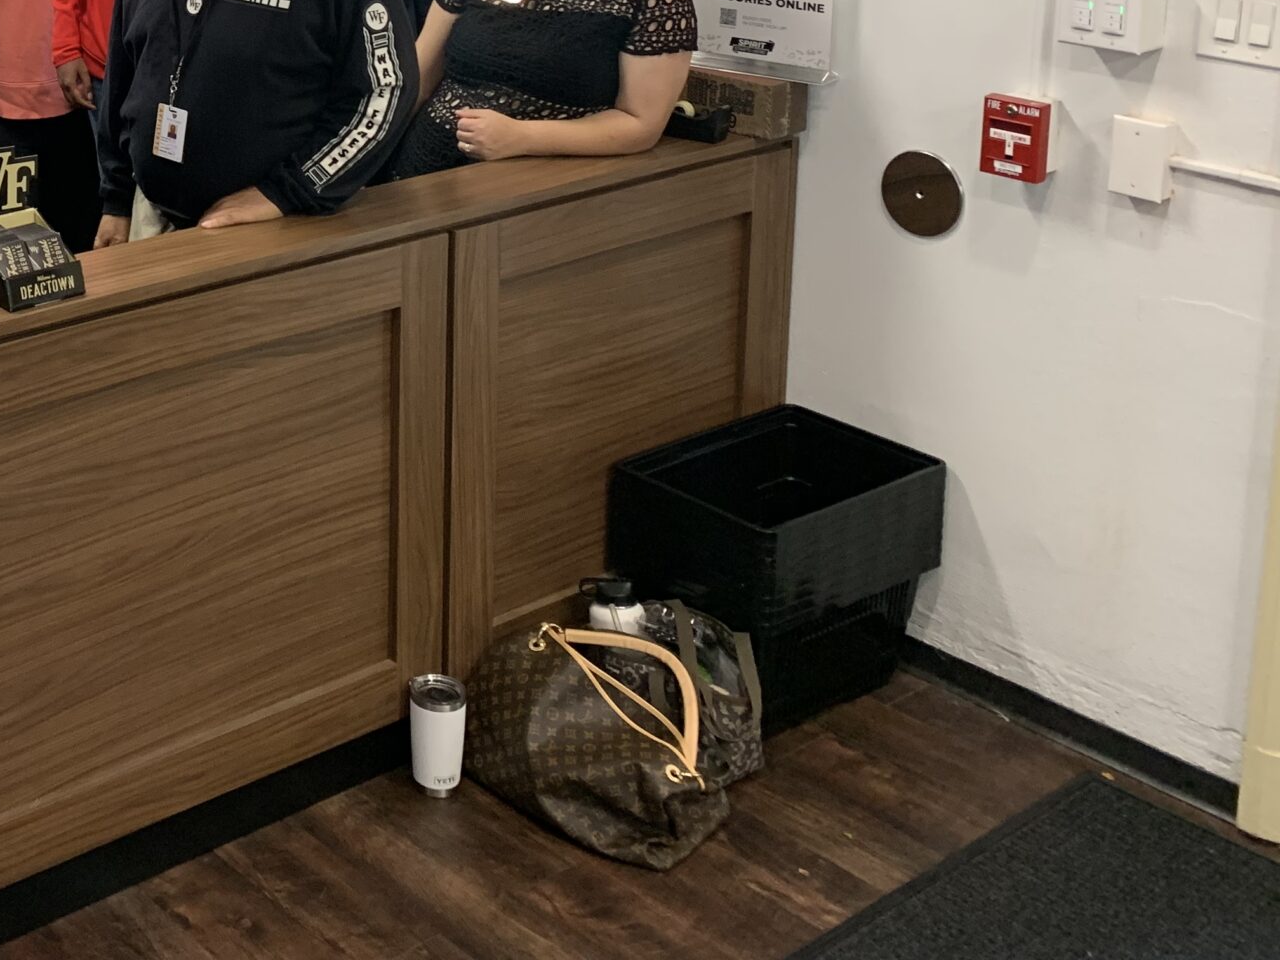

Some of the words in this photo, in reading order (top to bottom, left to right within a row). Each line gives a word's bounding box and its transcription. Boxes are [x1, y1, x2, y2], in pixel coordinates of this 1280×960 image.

[368, 10, 385, 24] WF
[738, 38, 767, 50] SPIRIT
[987, 99, 1001, 110] FIRE
[1018, 105, 1040, 118] ALARM
[1010, 134, 1027, 142] DOWN
[20, 275, 75, 300] DEACTOWN
